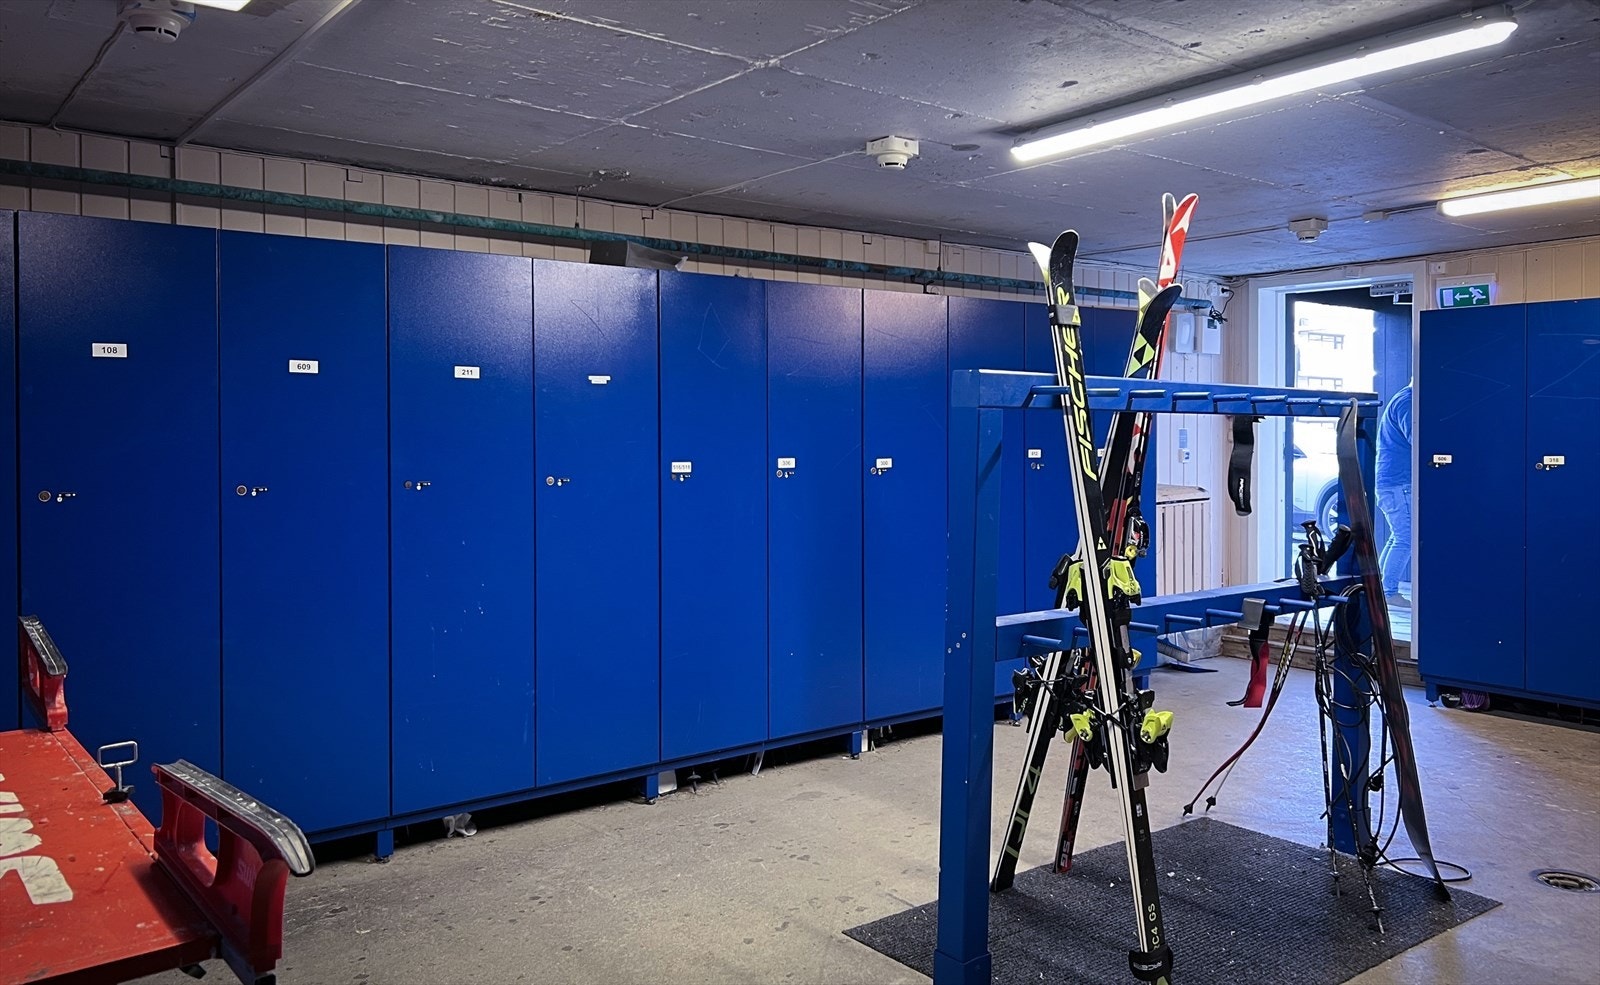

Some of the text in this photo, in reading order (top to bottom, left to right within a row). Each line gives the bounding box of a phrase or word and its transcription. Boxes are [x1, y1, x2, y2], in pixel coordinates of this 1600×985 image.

[102, 346, 118, 354] 108
[297, 363, 311, 371] 609
[1147, 903, 1157, 922] GS
